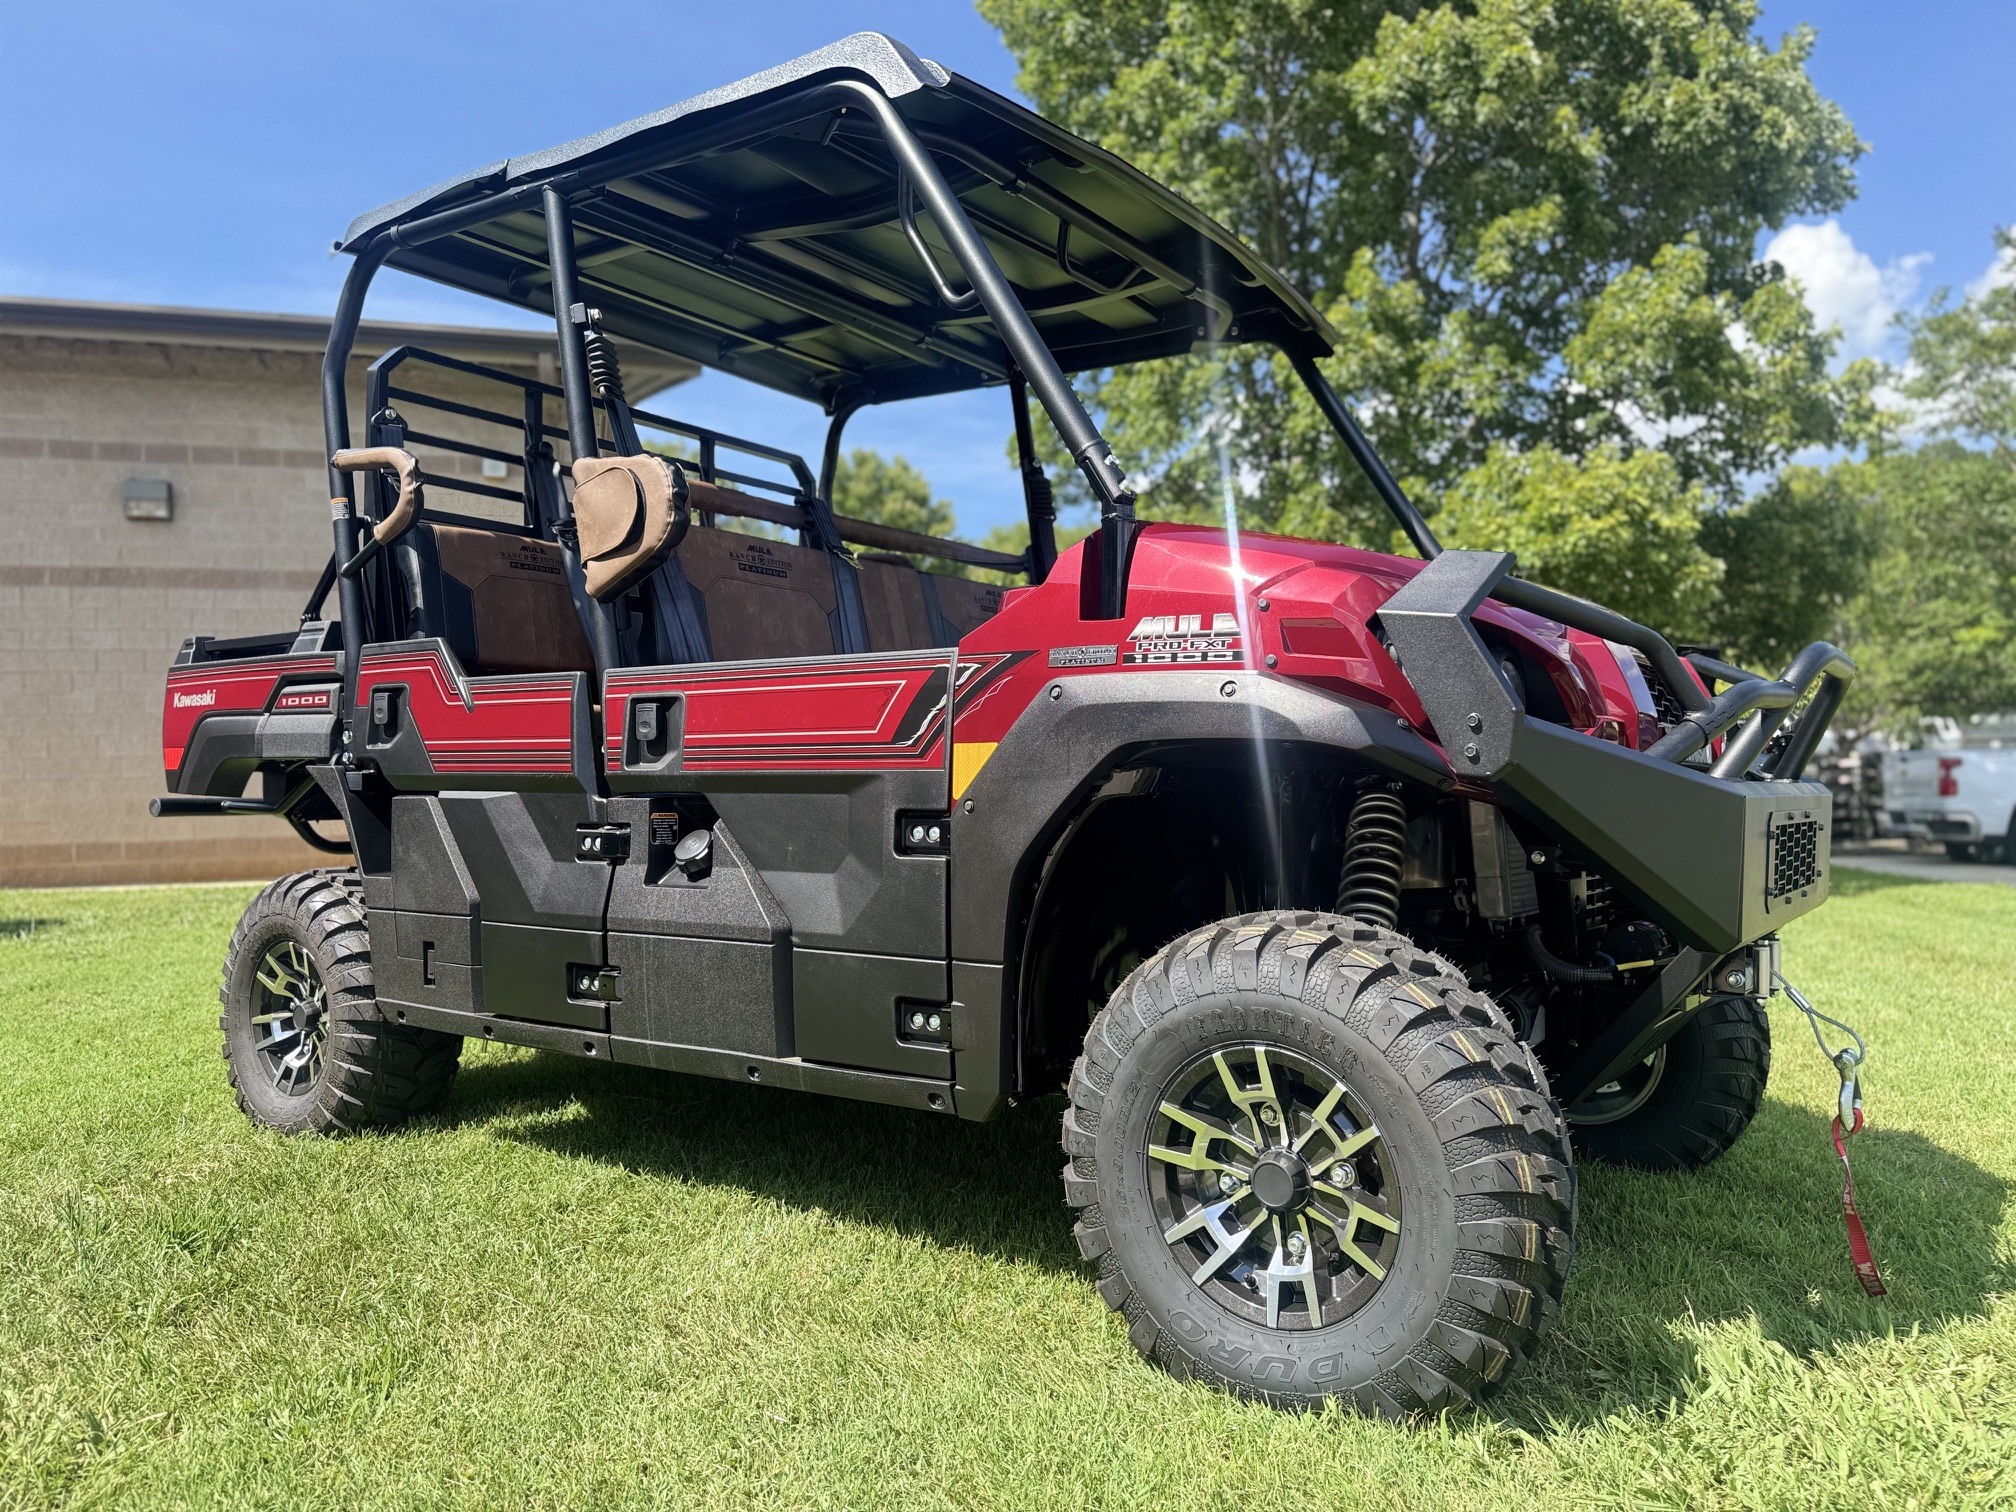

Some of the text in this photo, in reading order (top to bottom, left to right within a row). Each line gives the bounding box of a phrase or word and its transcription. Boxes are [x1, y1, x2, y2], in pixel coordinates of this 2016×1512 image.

[520, 545, 547, 555] MULE
[747, 544, 773, 556] MULE
[500, 551, 563, 566] RANCH EDITIO
[729, 550, 793, 569] RANCH EDITION
[510, 562, 560, 574] PLATINUM
[739, 563, 787, 577] PLATINUM
[1126, 612, 1245, 642] MULE
[1135, 636, 1233, 652] PRO-FXT
[1059, 657, 1106, 666] PLATINUM
[1133, 651, 1234, 663] 1000
[173, 689, 217, 708] Kawasaki
[281, 695, 328, 707] 1000
[1188, 1005, 1360, 1074] FRONTIER
[1169, 1308, 1344, 1383] DURO
